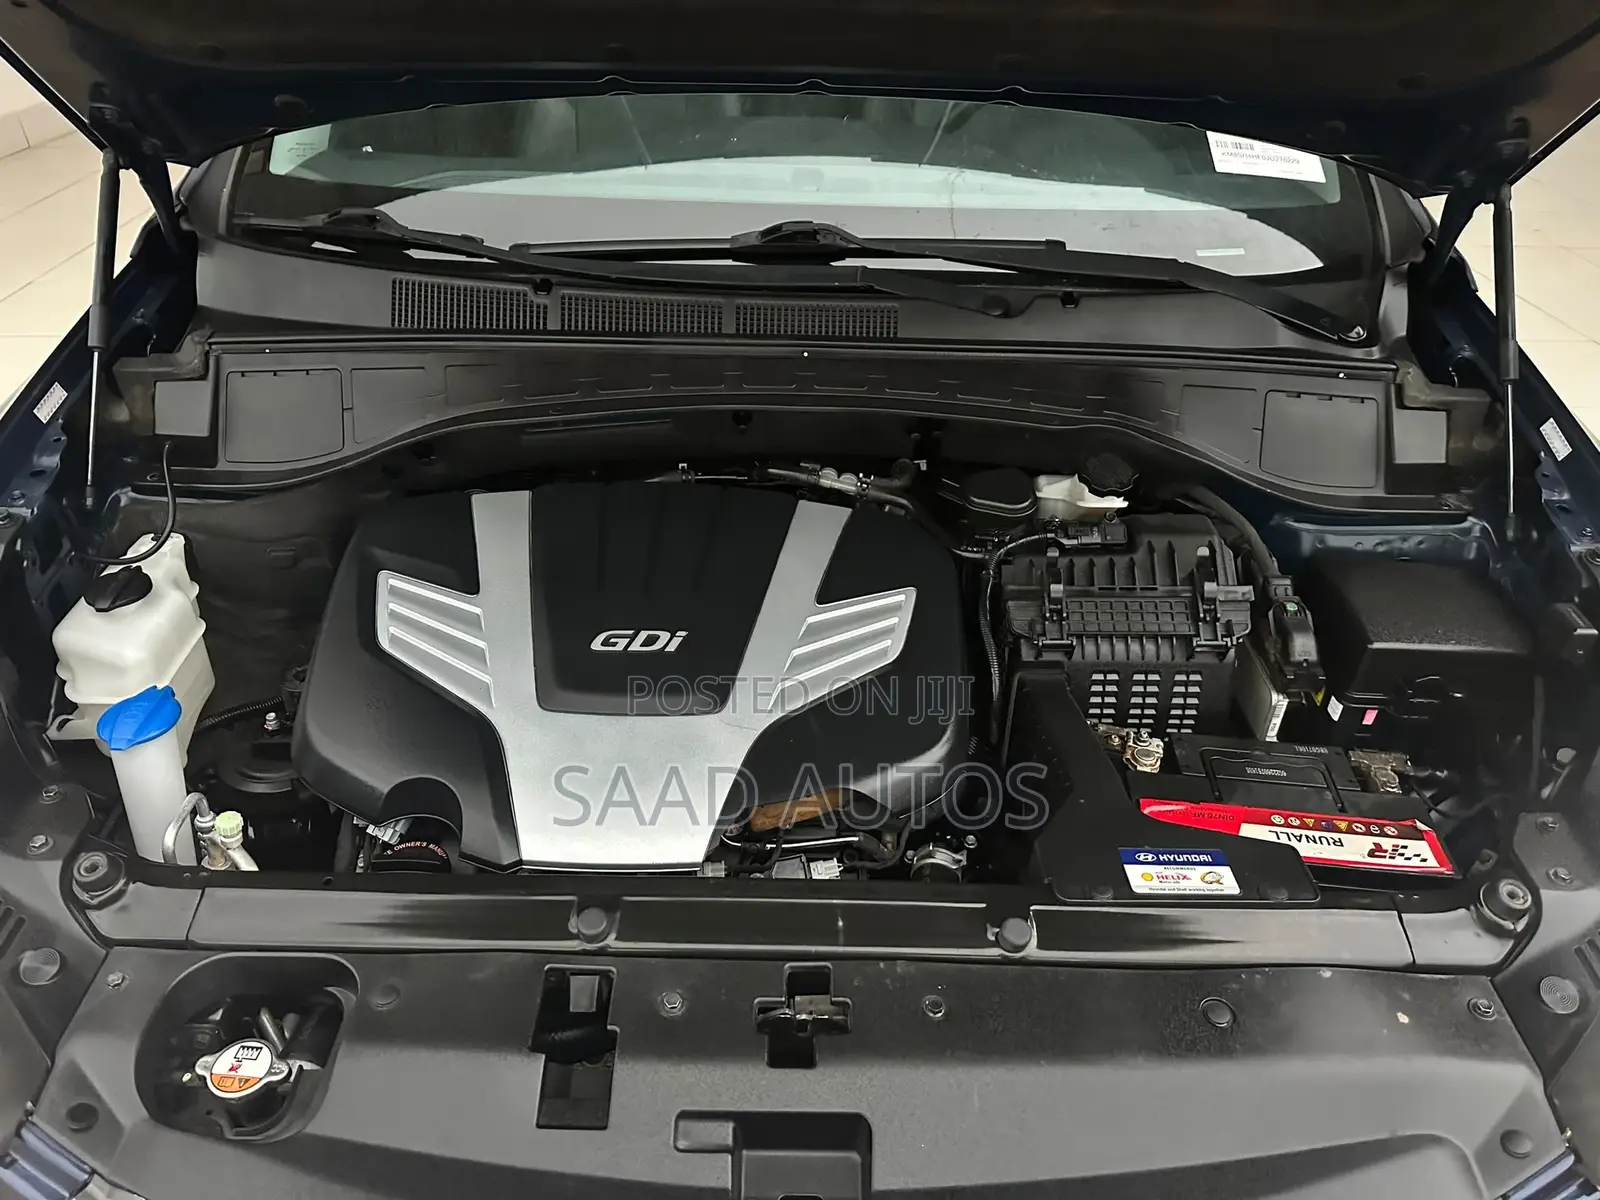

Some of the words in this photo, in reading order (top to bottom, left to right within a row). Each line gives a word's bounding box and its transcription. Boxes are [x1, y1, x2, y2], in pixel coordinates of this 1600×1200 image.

[590, 630, 689, 652] GDi
[1268, 829, 1345, 848] RUNALL
[393, 841, 428, 851] OWNER'S
[1158, 853, 1213, 862] HYUNDAI
[1155, 873, 1193, 881] HELIX
